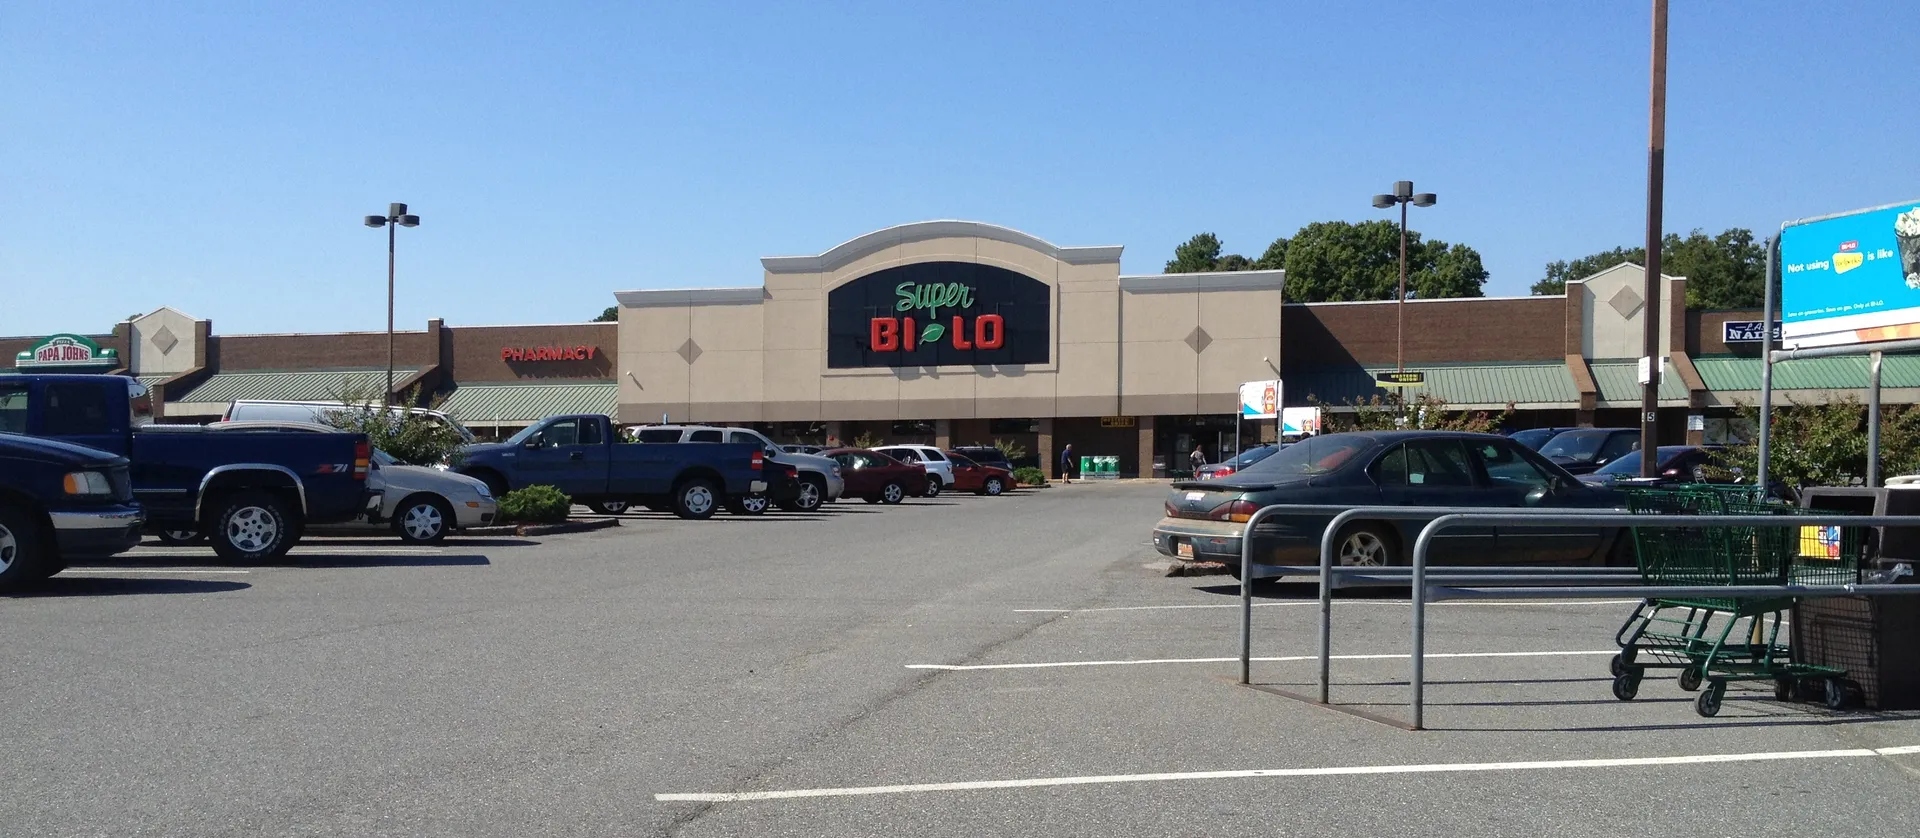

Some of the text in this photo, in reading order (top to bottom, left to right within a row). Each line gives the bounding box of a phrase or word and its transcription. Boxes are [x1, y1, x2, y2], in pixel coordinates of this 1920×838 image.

[1787, 263, 1804, 273] Not
[1806, 260, 1829, 270] using
[1867, 251, 1875, 260] is
[1877, 248, 1893, 259] like
[895, 281, 974, 319] Super
[1729, 327, 1780, 339] NAIS
[38, 346, 59, 361] PAPA
[501, 345, 596, 361] PHARMACY
